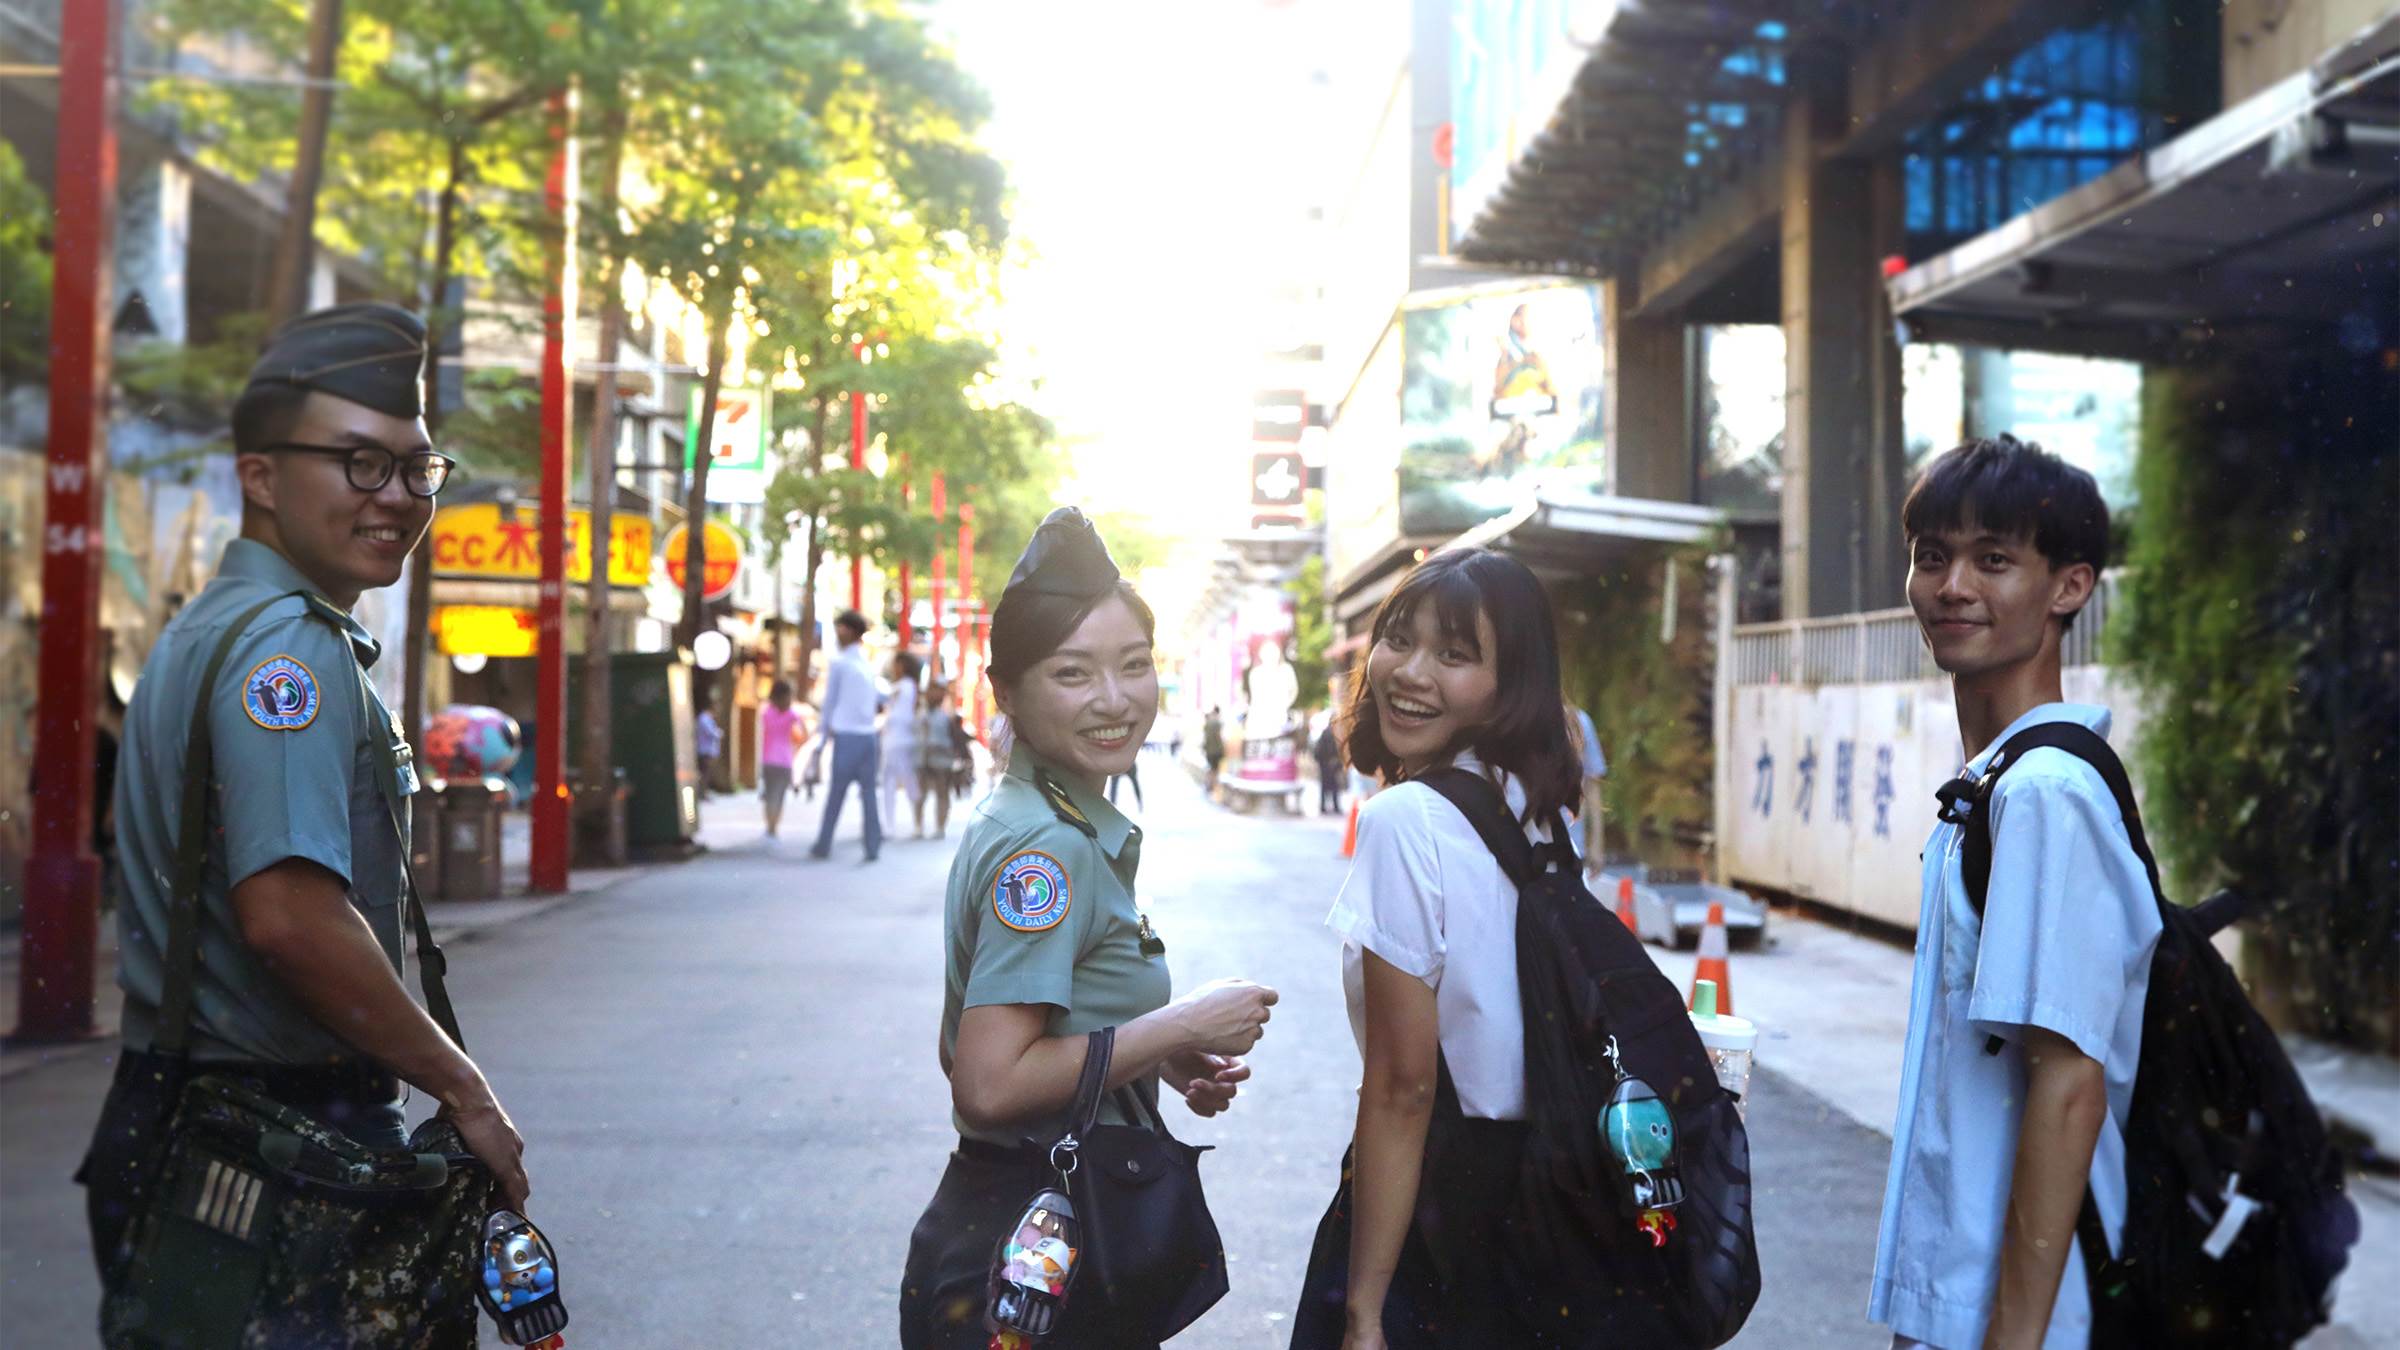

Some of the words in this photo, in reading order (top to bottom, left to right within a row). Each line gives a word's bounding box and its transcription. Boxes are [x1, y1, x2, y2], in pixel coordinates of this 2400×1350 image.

[51, 465, 84, 494] W
[47, 524, 86, 553] 54
[998, 899, 1023, 925] YOUTH
[1025, 914, 1054, 926] DAILY
[1053, 888, 1067, 916] NEWS
